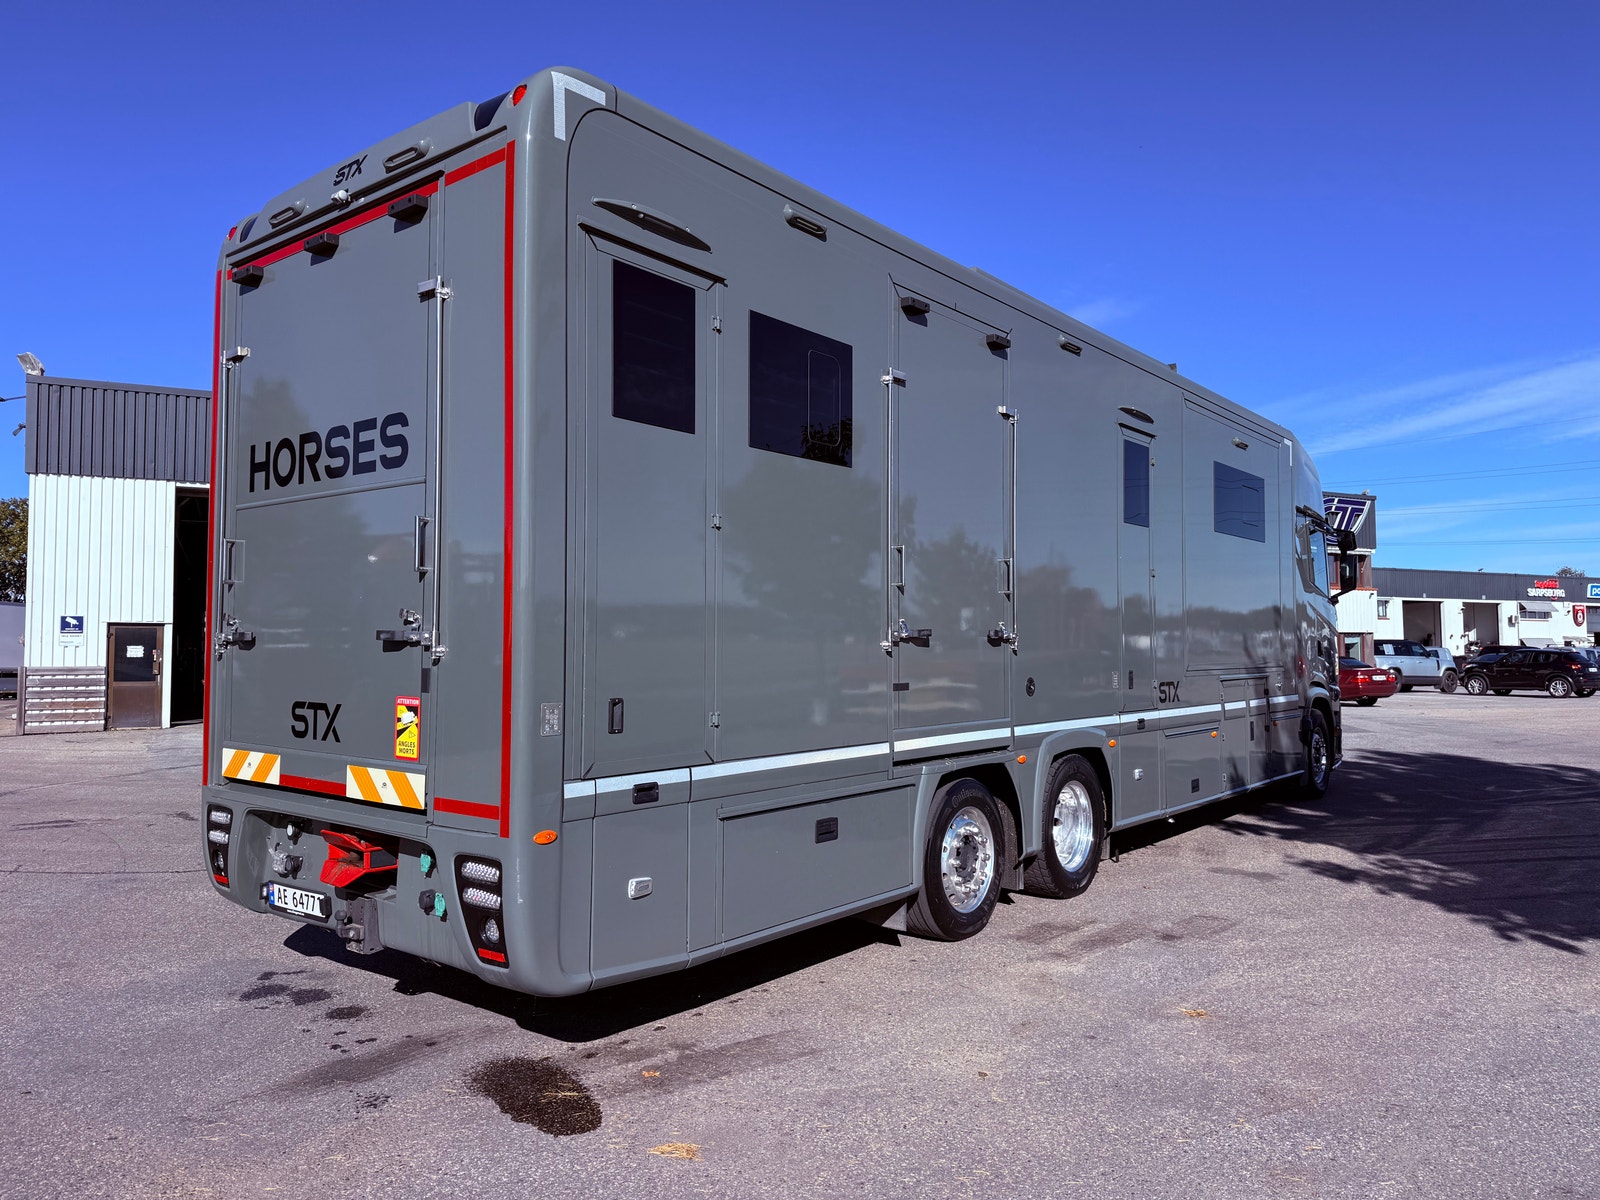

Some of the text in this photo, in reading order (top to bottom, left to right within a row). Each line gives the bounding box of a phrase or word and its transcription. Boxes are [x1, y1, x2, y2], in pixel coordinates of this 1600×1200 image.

[333, 154, 368, 186] STX
[249, 412, 409, 493] HORSES
[1527, 588, 1565, 598] SARPSBORG
[1159, 681, 1180, 703] STX
[291, 701, 342, 743] STX
[398, 740, 416, 748] ANGLES
[277, 887, 289, 905] AE
